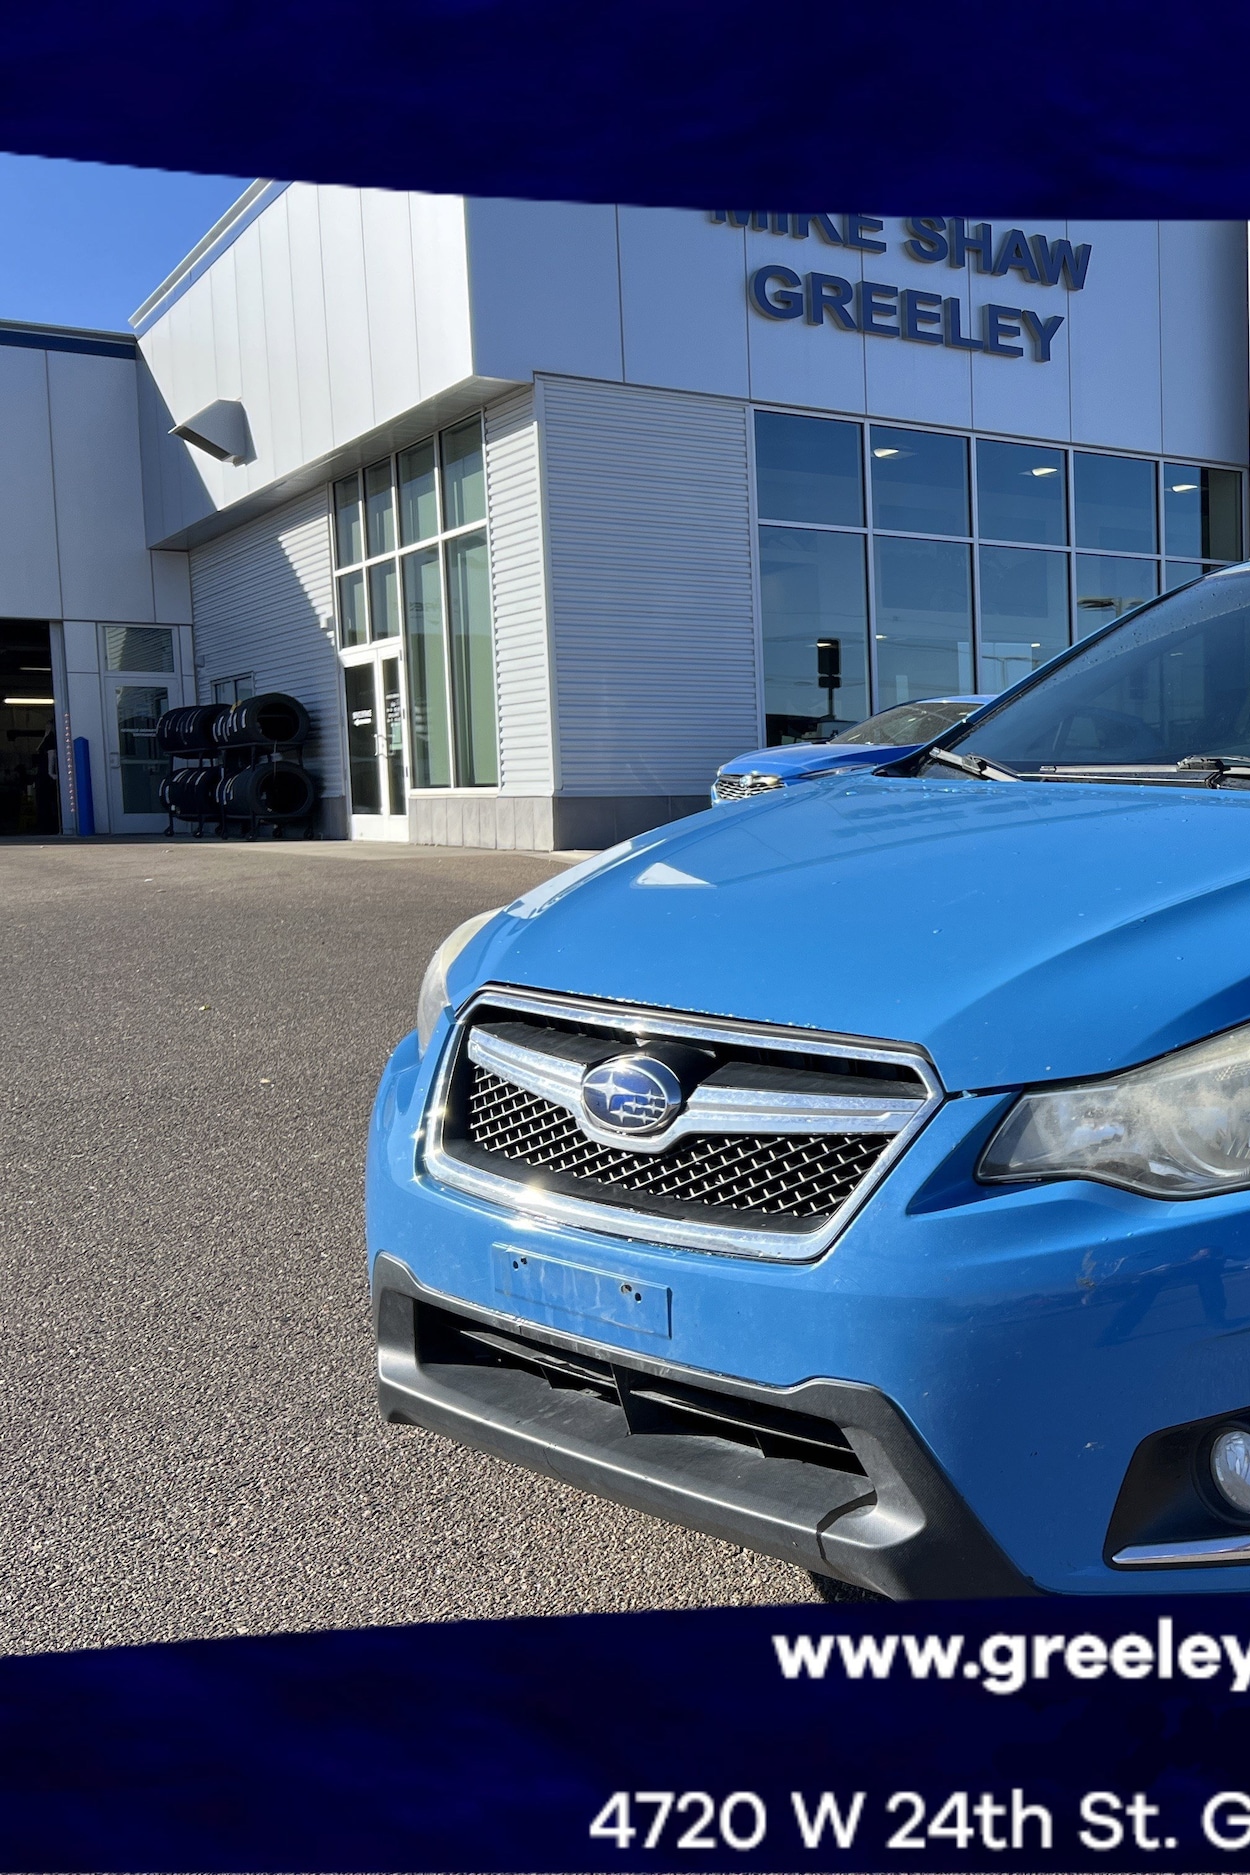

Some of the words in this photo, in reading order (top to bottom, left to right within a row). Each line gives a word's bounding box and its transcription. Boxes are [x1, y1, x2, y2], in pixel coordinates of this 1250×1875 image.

[710, 210, 888, 254] KE
[903, 214, 1092, 291] SHAW
[749, 264, 1065, 362] GREELEY
